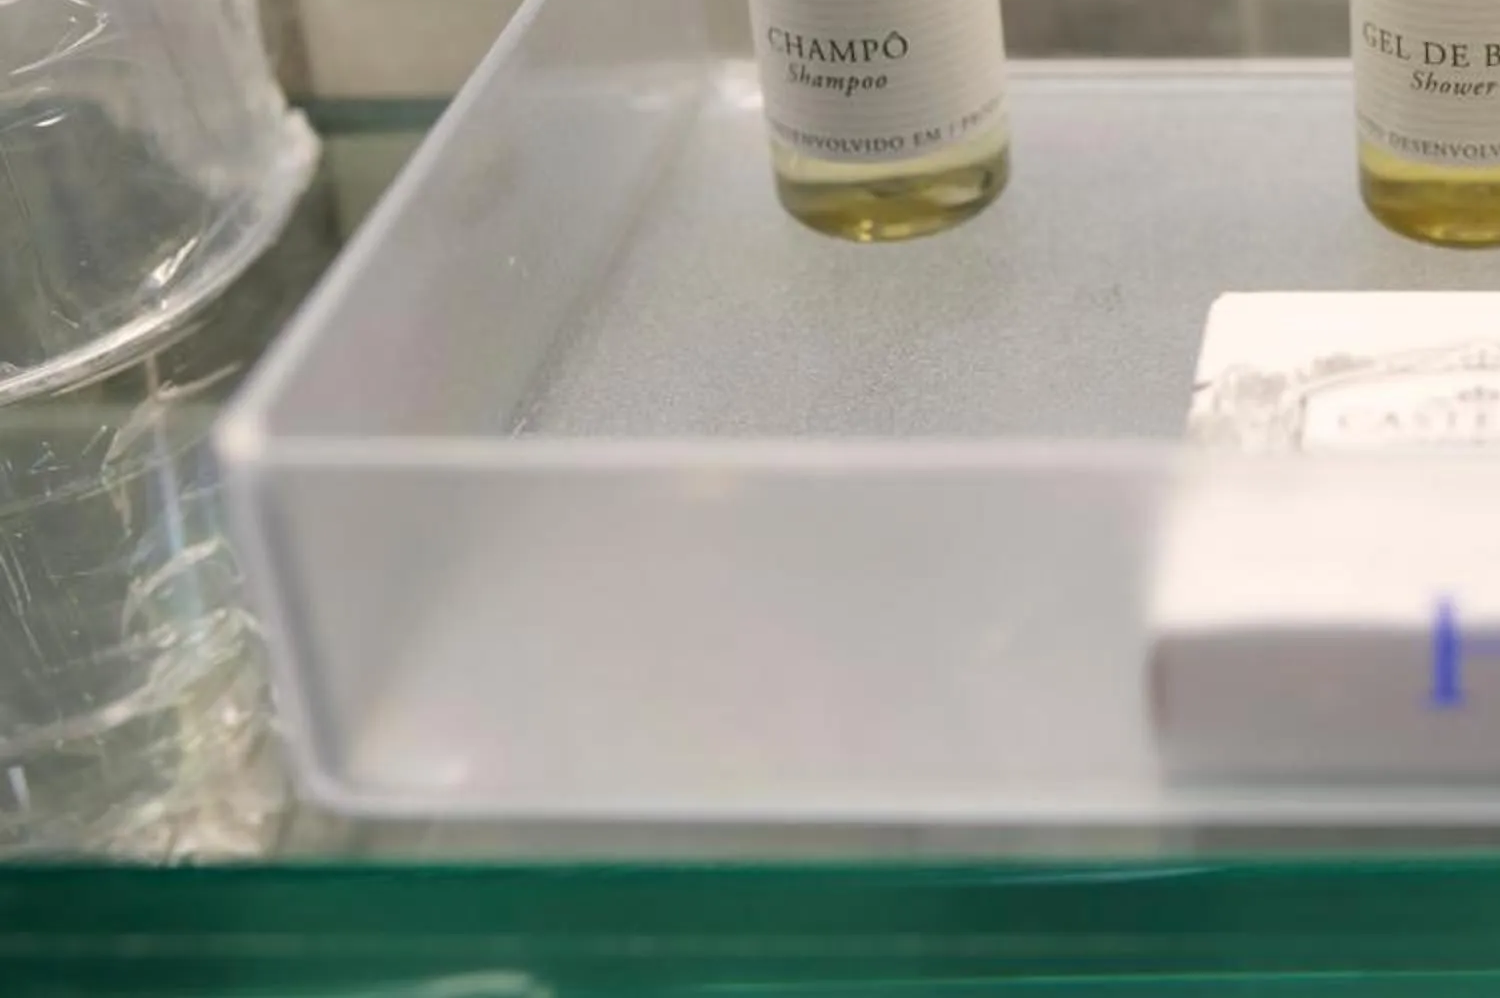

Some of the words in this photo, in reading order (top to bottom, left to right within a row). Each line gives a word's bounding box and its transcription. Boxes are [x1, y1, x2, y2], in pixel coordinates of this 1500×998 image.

[768, 26, 909, 63] CHAMPÔ
[1362, 20, 1411, 61] GEL
[1423, 40, 1470, 68] DE
[787, 62, 888, 97] Shampoo
[1410, 69, 1498, 96] Shower
